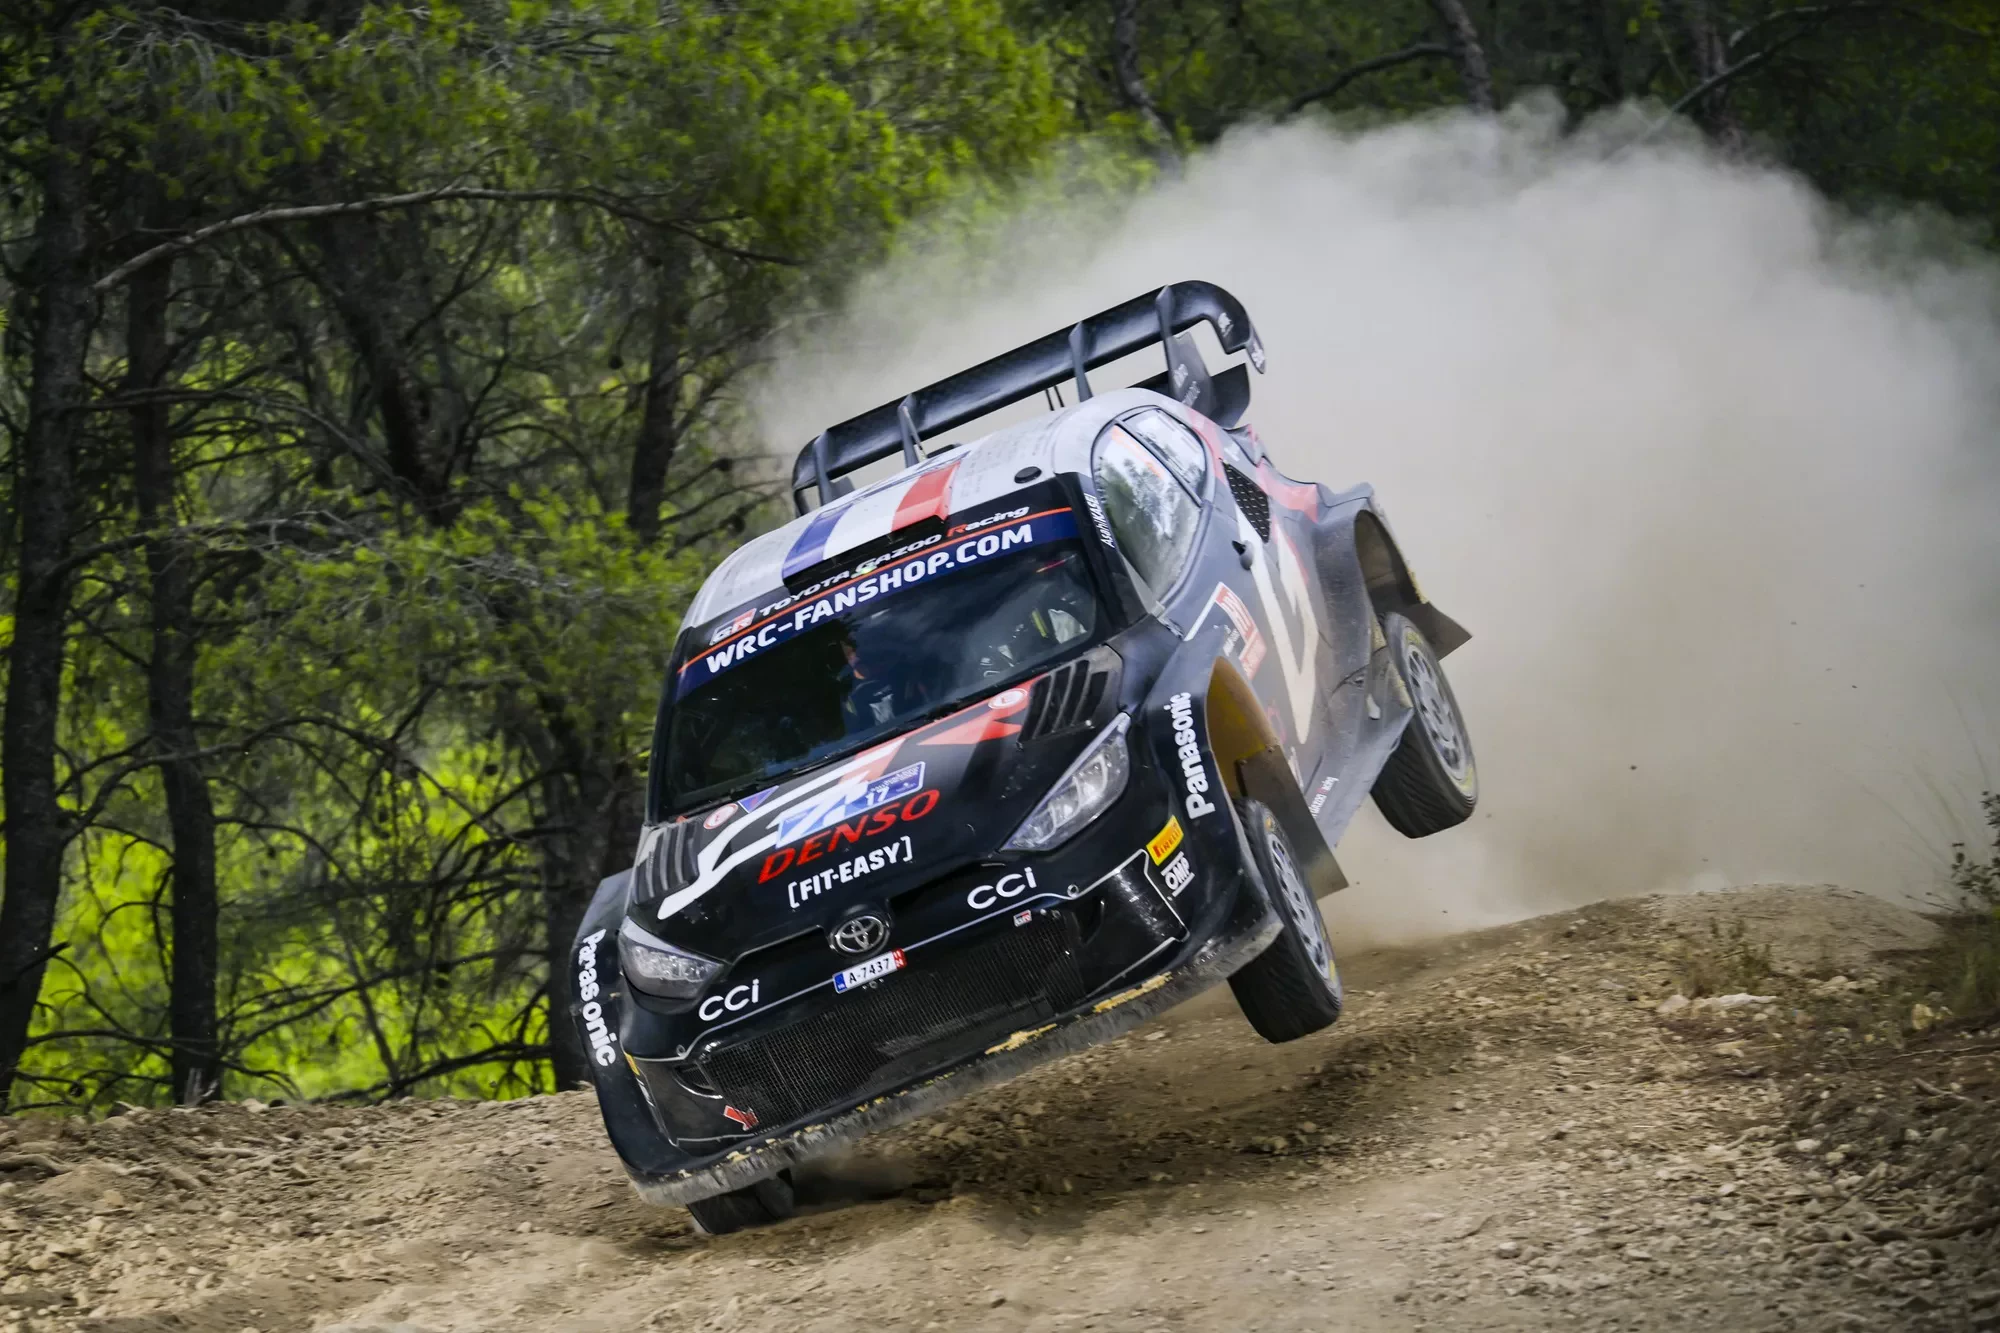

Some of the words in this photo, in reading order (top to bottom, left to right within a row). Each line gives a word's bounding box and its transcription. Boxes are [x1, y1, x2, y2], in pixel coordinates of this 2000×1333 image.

[705, 523, 1034, 674] WRC-FANSHOP.COM
[758, 569, 851, 617] TOYOTA
[850, 533, 942, 580] GAZOO
[946, 505, 1031, 537] Racing
[865, 785, 890, 805] 17
[1163, 691, 1216, 820] Panasonic
[757, 789, 941, 885] DENSO
[1164, 857, 1190, 890] OMP
[578, 928, 618, 1067] Panasonic
[848, 958, 890, 984] A-7437
